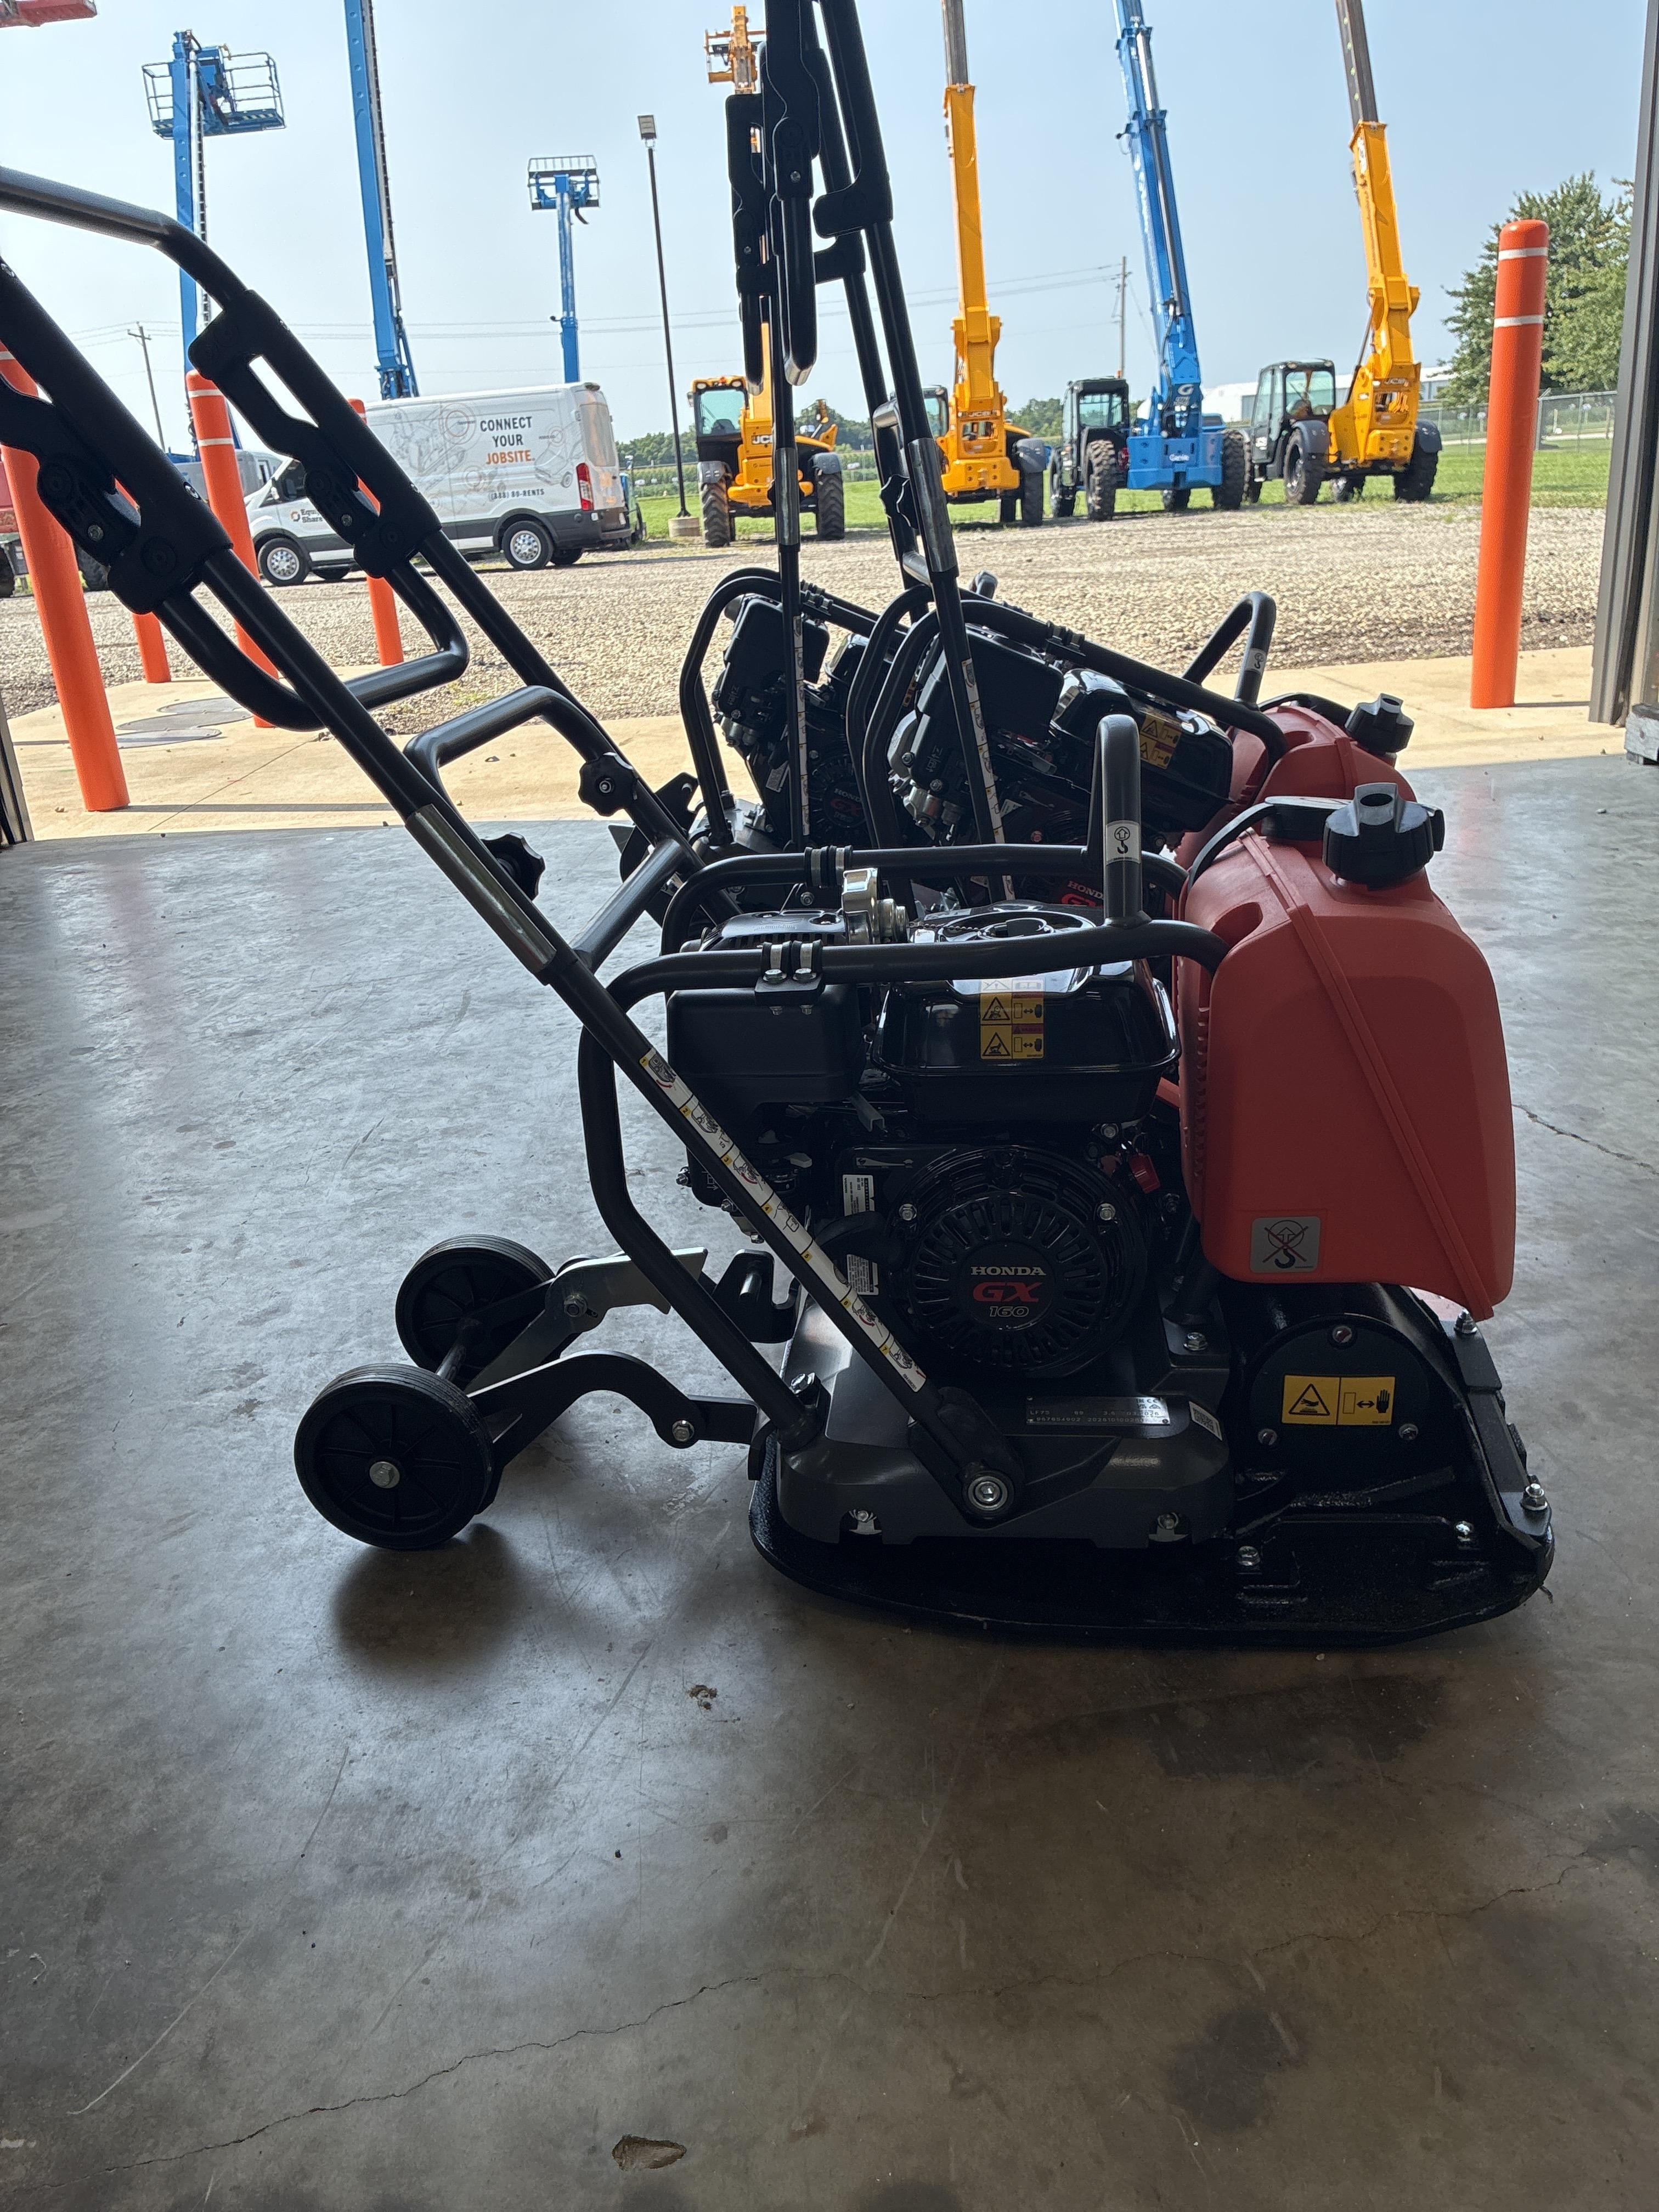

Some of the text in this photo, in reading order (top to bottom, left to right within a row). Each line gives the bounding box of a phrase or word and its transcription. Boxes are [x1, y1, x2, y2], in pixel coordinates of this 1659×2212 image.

[480, 416, 533, 432] CONNECT
[492, 434, 524, 448] YOUR
[1068, 881, 1104, 900] HOND
[970, 1267, 1046, 1276] HONDA
[973, 1282, 1043, 1302] GX
[990, 1306, 1029, 1317] 160
